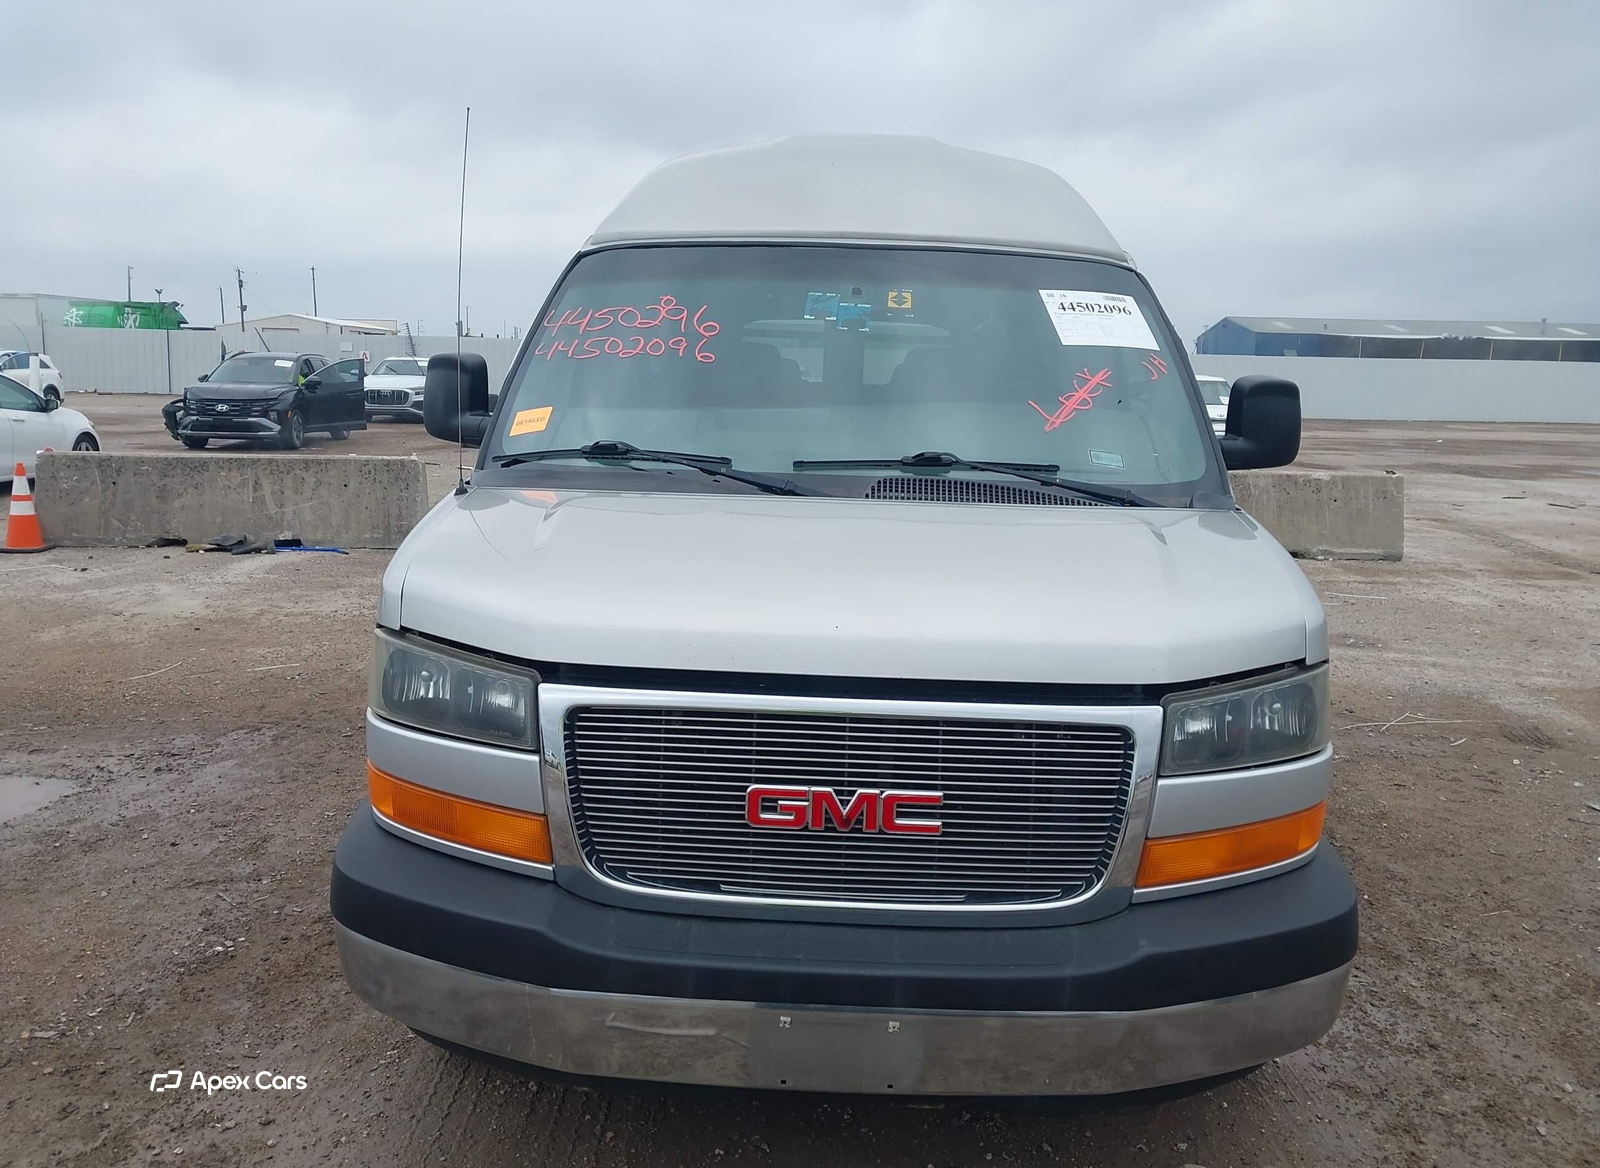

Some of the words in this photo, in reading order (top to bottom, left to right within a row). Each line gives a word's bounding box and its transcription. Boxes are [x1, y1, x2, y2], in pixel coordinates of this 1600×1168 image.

[1057, 301, 1132, 316] 44502096
[534, 335, 717, 363] 44502096
[516, 416, 546, 426] DETAILED
[745, 784, 944, 835] GMC
